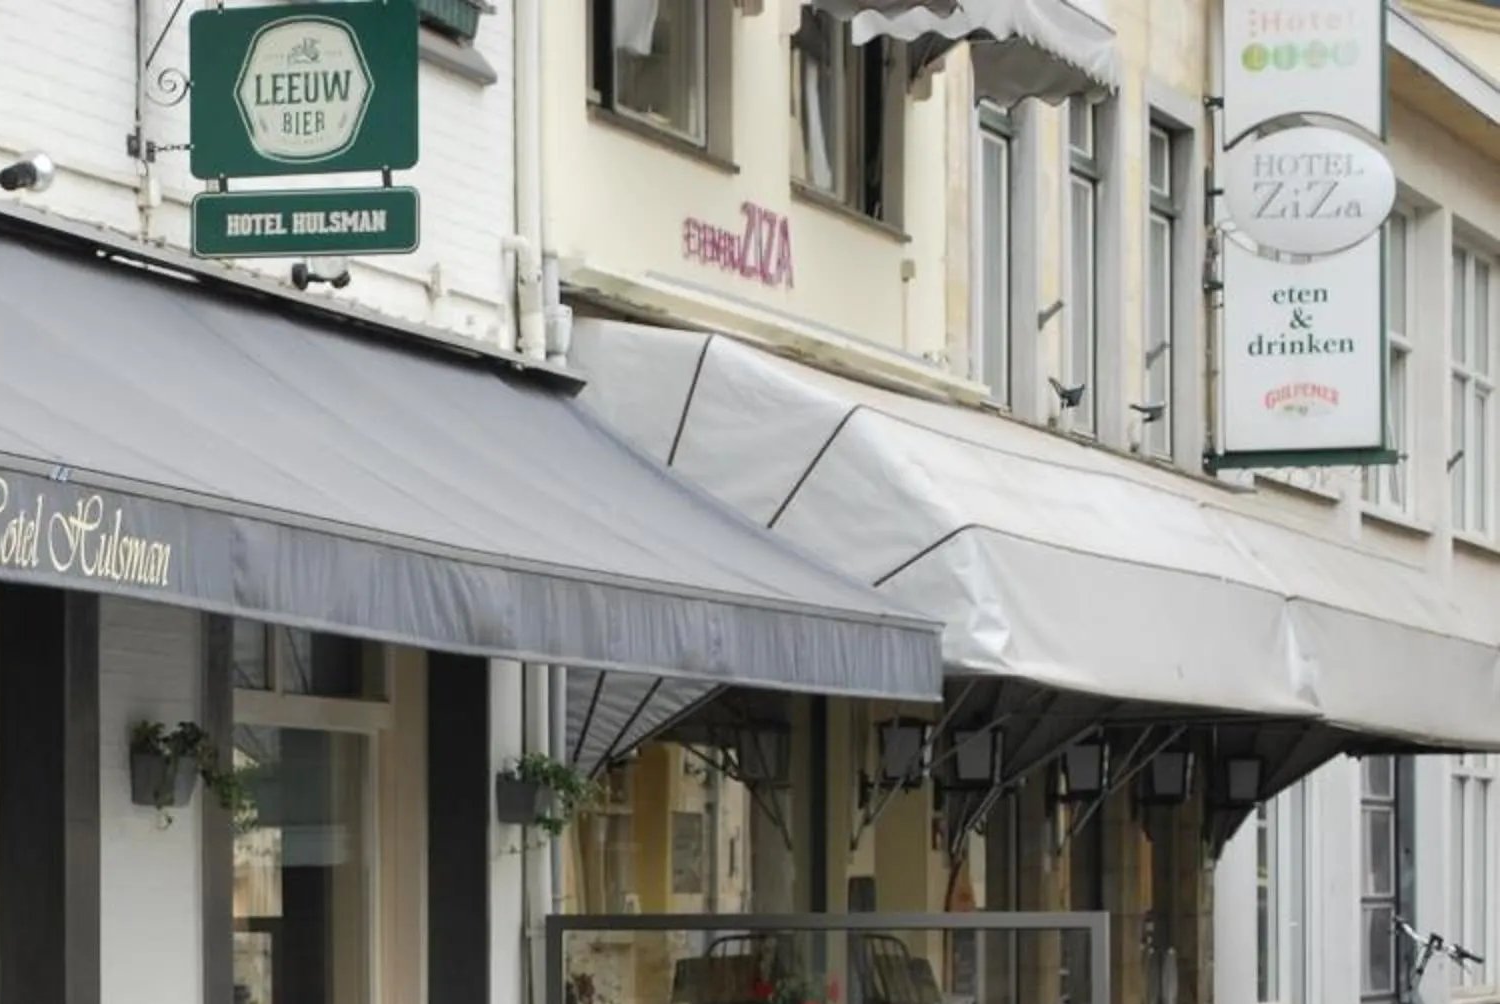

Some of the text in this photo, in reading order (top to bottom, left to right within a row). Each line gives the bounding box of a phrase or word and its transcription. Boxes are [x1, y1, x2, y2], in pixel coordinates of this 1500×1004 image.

[255, 70, 352, 106] LEEUW
[283, 111, 325, 136] BIER
[1253, 153, 1364, 178] HOTEL
[226, 210, 387, 237] HOTEL HULSMAN
[1272, 286, 1329, 304] eten
[1289, 308, 1314, 330] &
[1247, 333, 1355, 357] drinken
[49, 495, 171, 587] Hulsman
